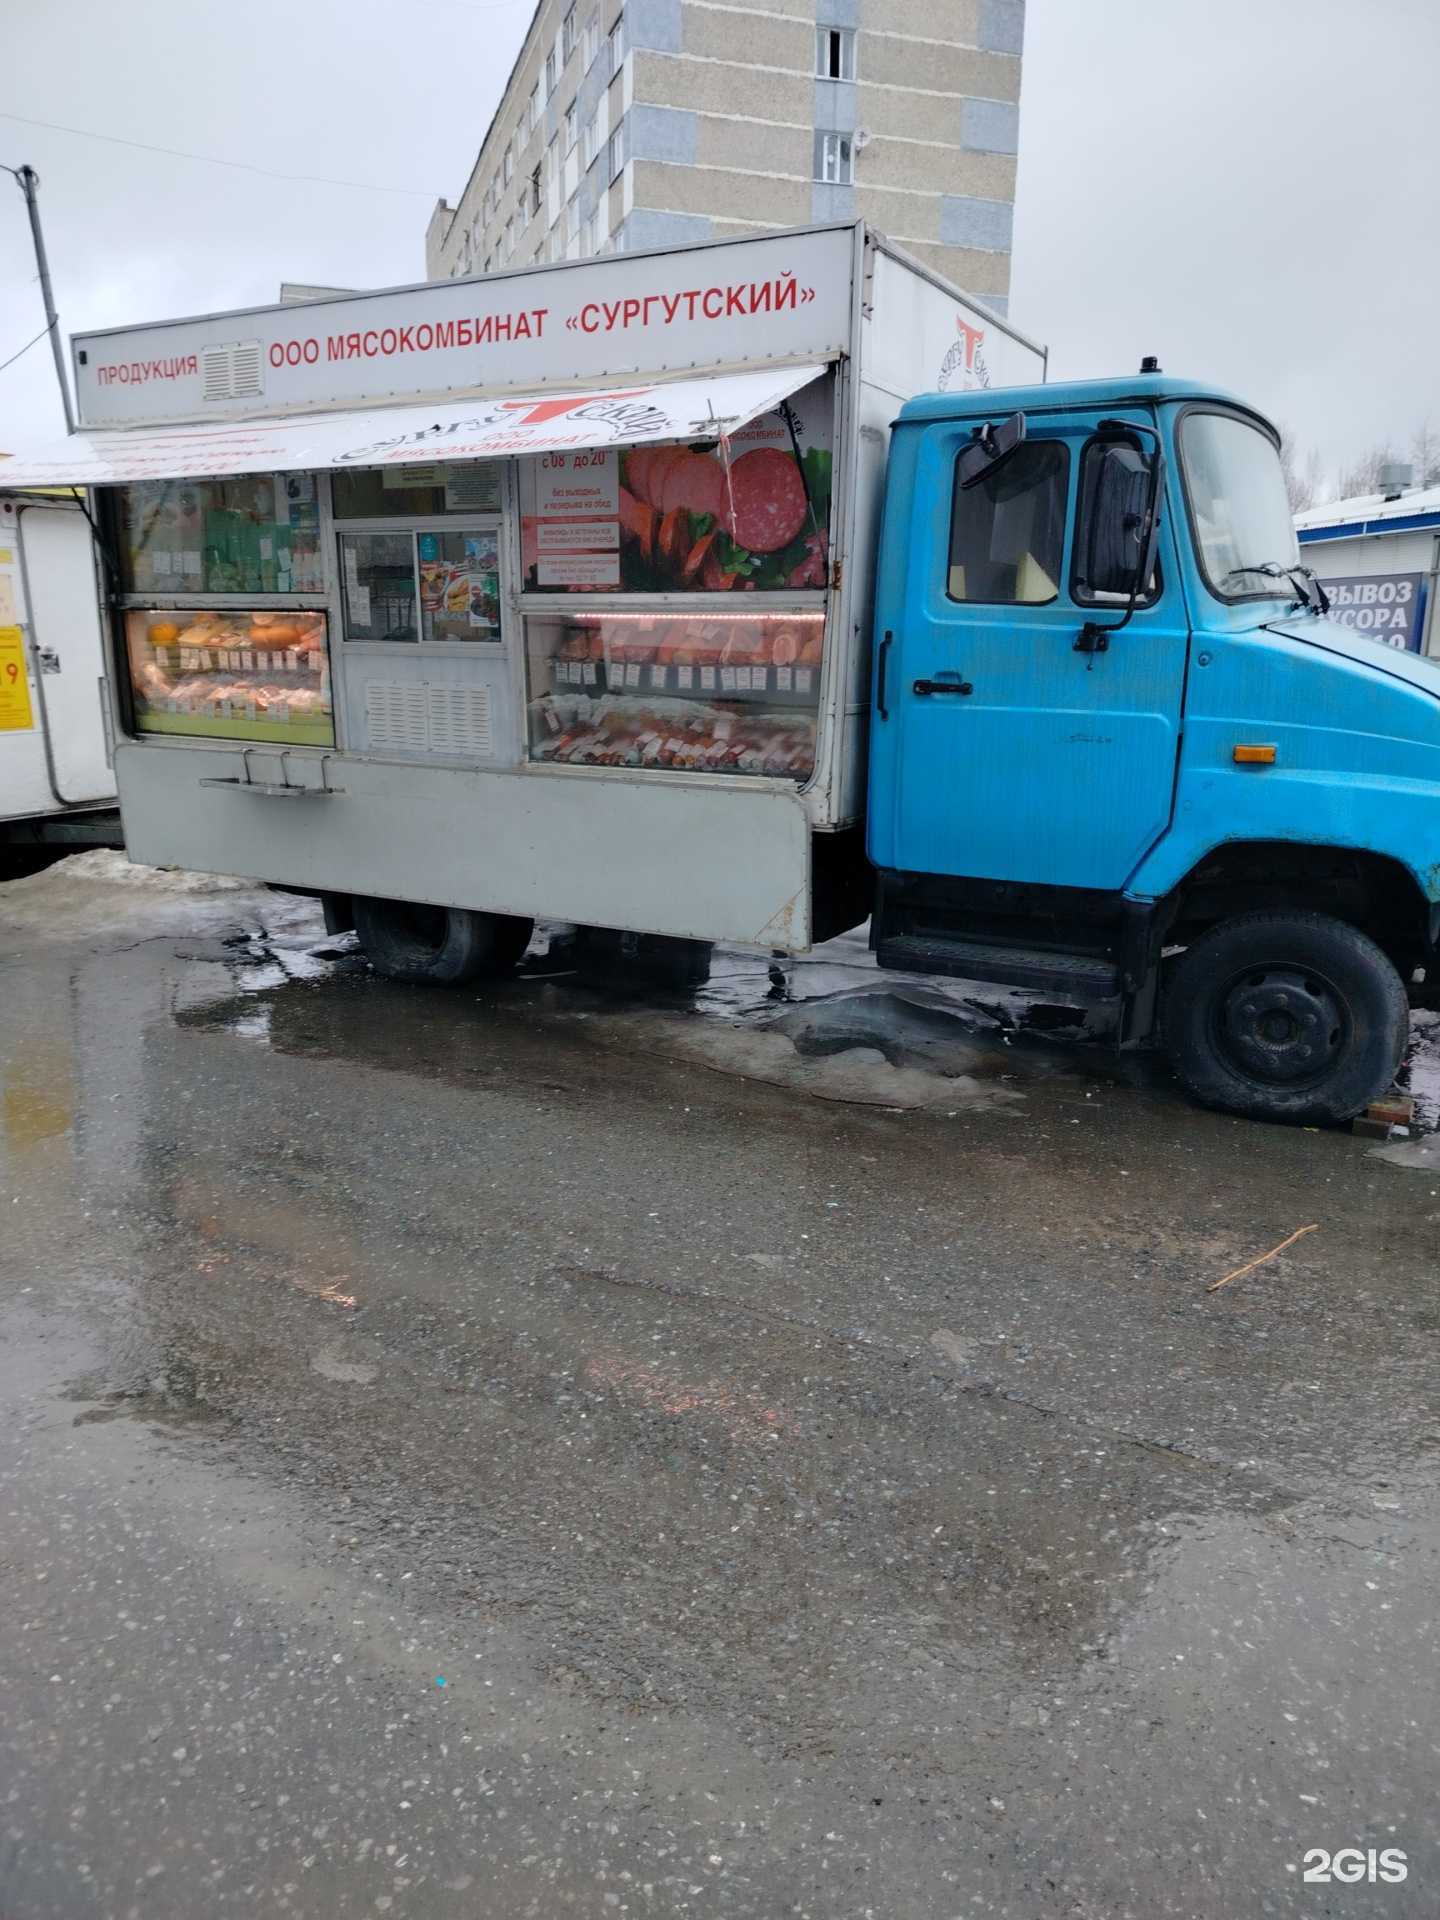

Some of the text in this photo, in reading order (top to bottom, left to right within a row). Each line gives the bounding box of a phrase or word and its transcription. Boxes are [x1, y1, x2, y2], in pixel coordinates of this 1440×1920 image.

[97, 271, 816, 386] ПРОДУКЦИЯ ООО МЯСОКОМБИНАТ «СУРГУТСКИЙ»
[551, 454, 566, 468] 08
[573, 455, 589, 470] до
[1322, 581, 1413, 607] ВЫВОЗ
